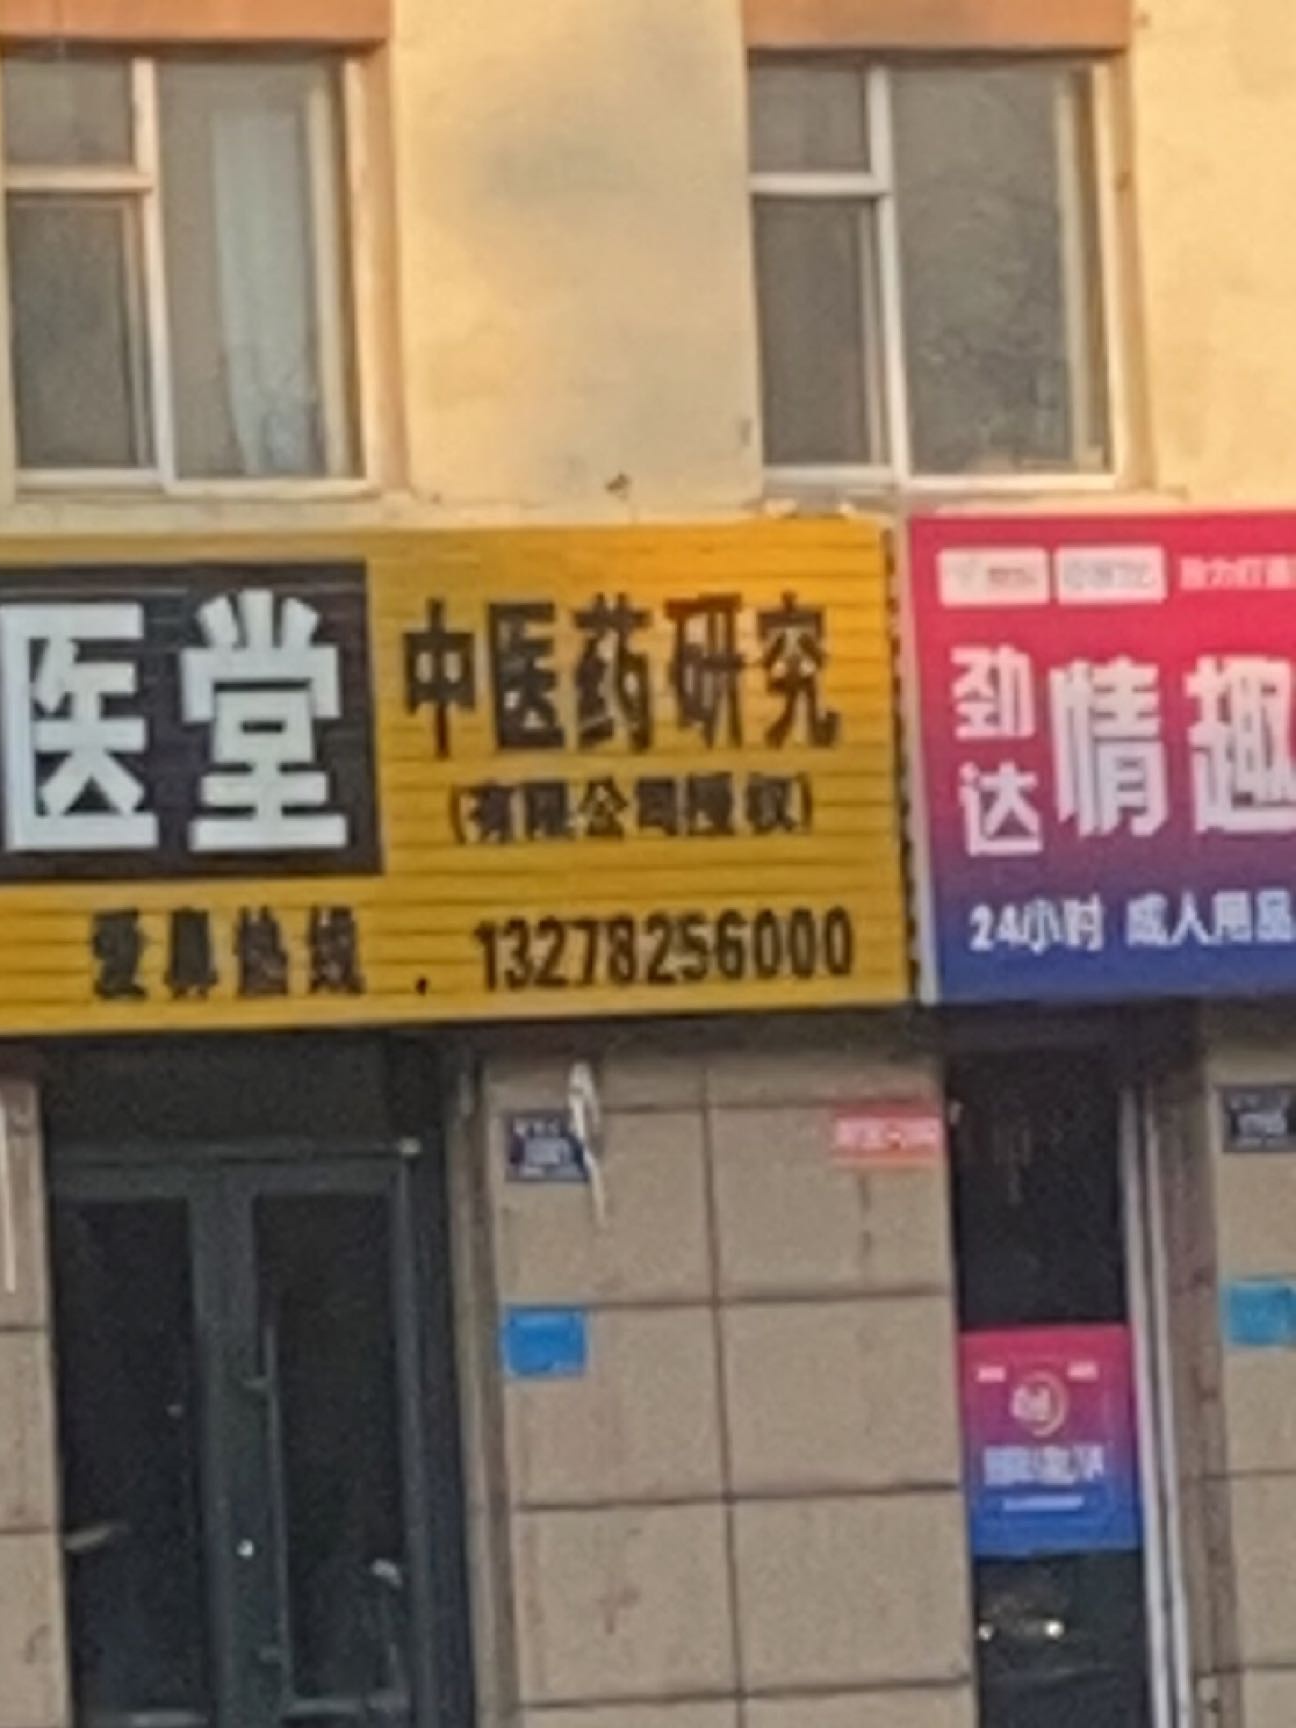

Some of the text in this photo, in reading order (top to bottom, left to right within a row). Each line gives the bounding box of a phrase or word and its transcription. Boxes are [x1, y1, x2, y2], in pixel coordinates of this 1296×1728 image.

[403, 592, 841, 758] 中医药研究
[950, 643, 1044, 856] 劲达
[1047, 653, 1296, 836] 情趣
[474, 905, 854, 992] 13278256000
[969, 888, 1296, 954] 24小时 成人用品
